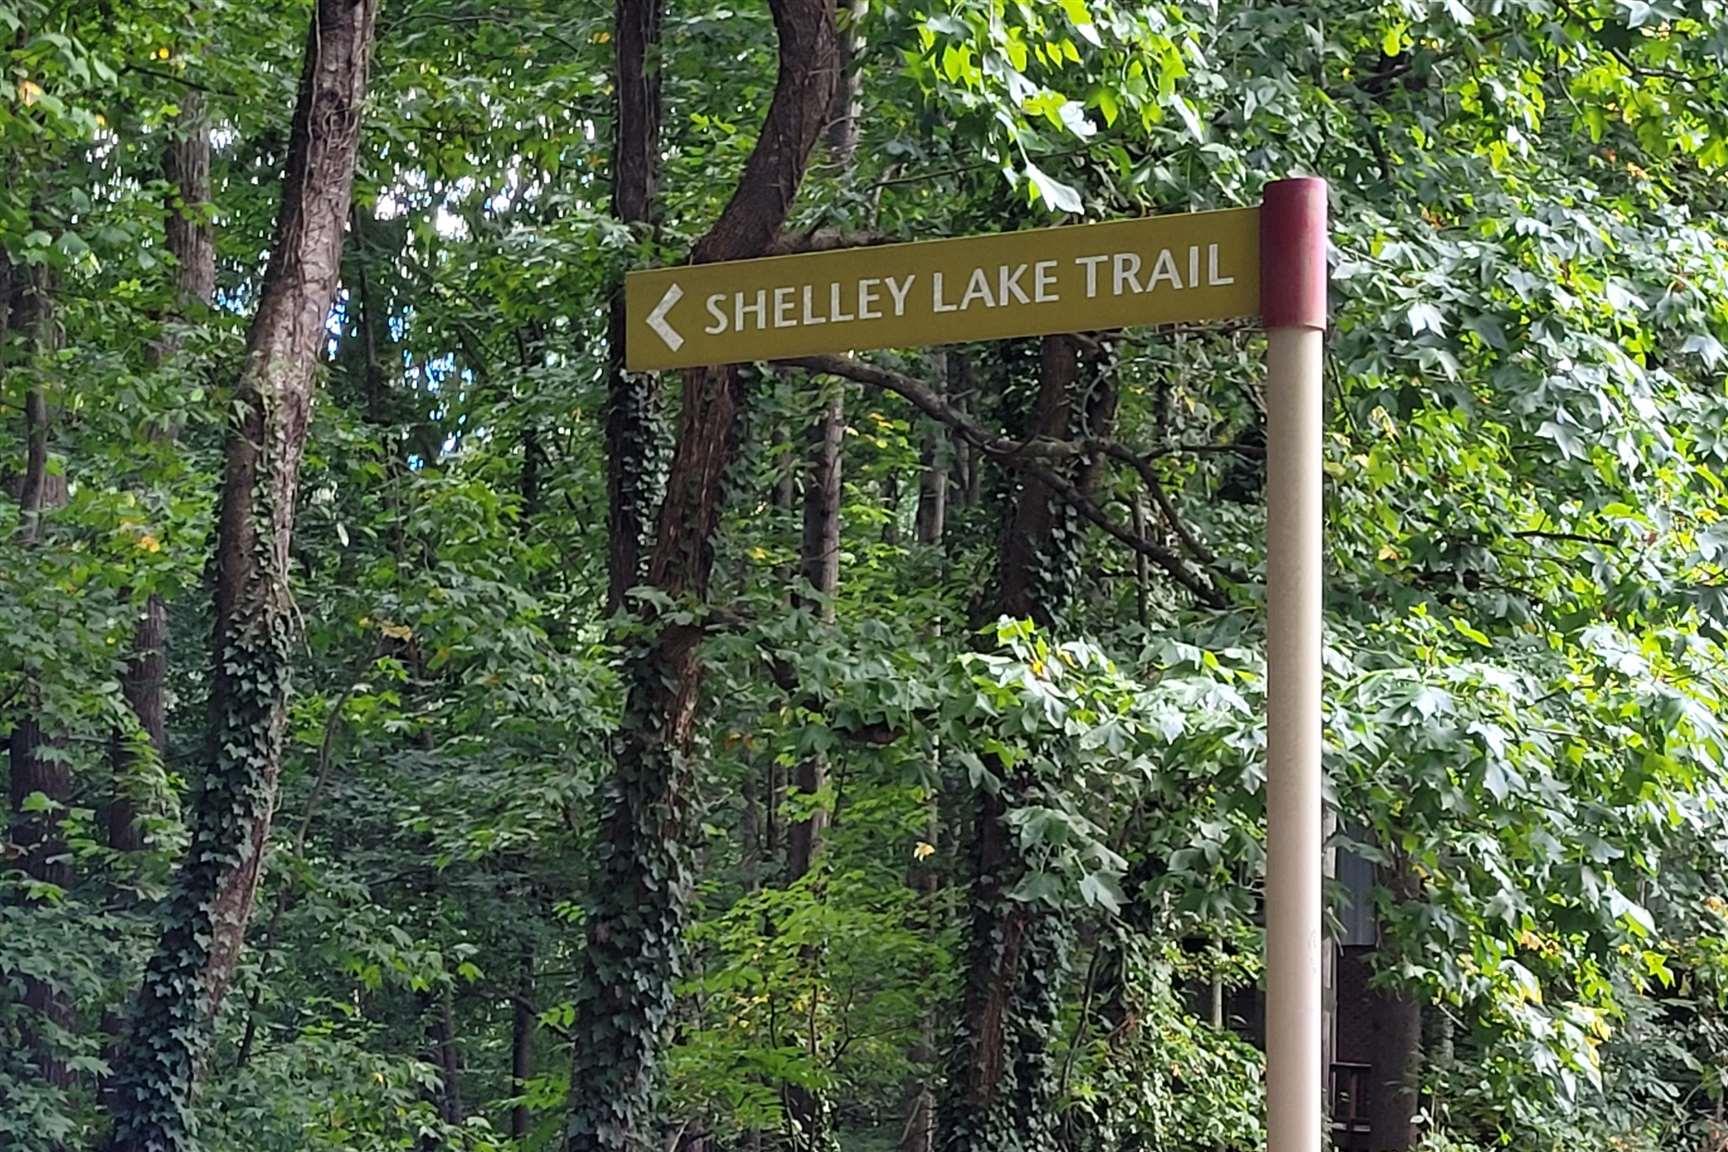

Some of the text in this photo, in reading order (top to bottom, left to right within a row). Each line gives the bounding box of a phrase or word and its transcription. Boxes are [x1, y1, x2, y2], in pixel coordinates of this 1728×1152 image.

[704, 244, 1235, 335] SHELLEY LAKE TRAIL
